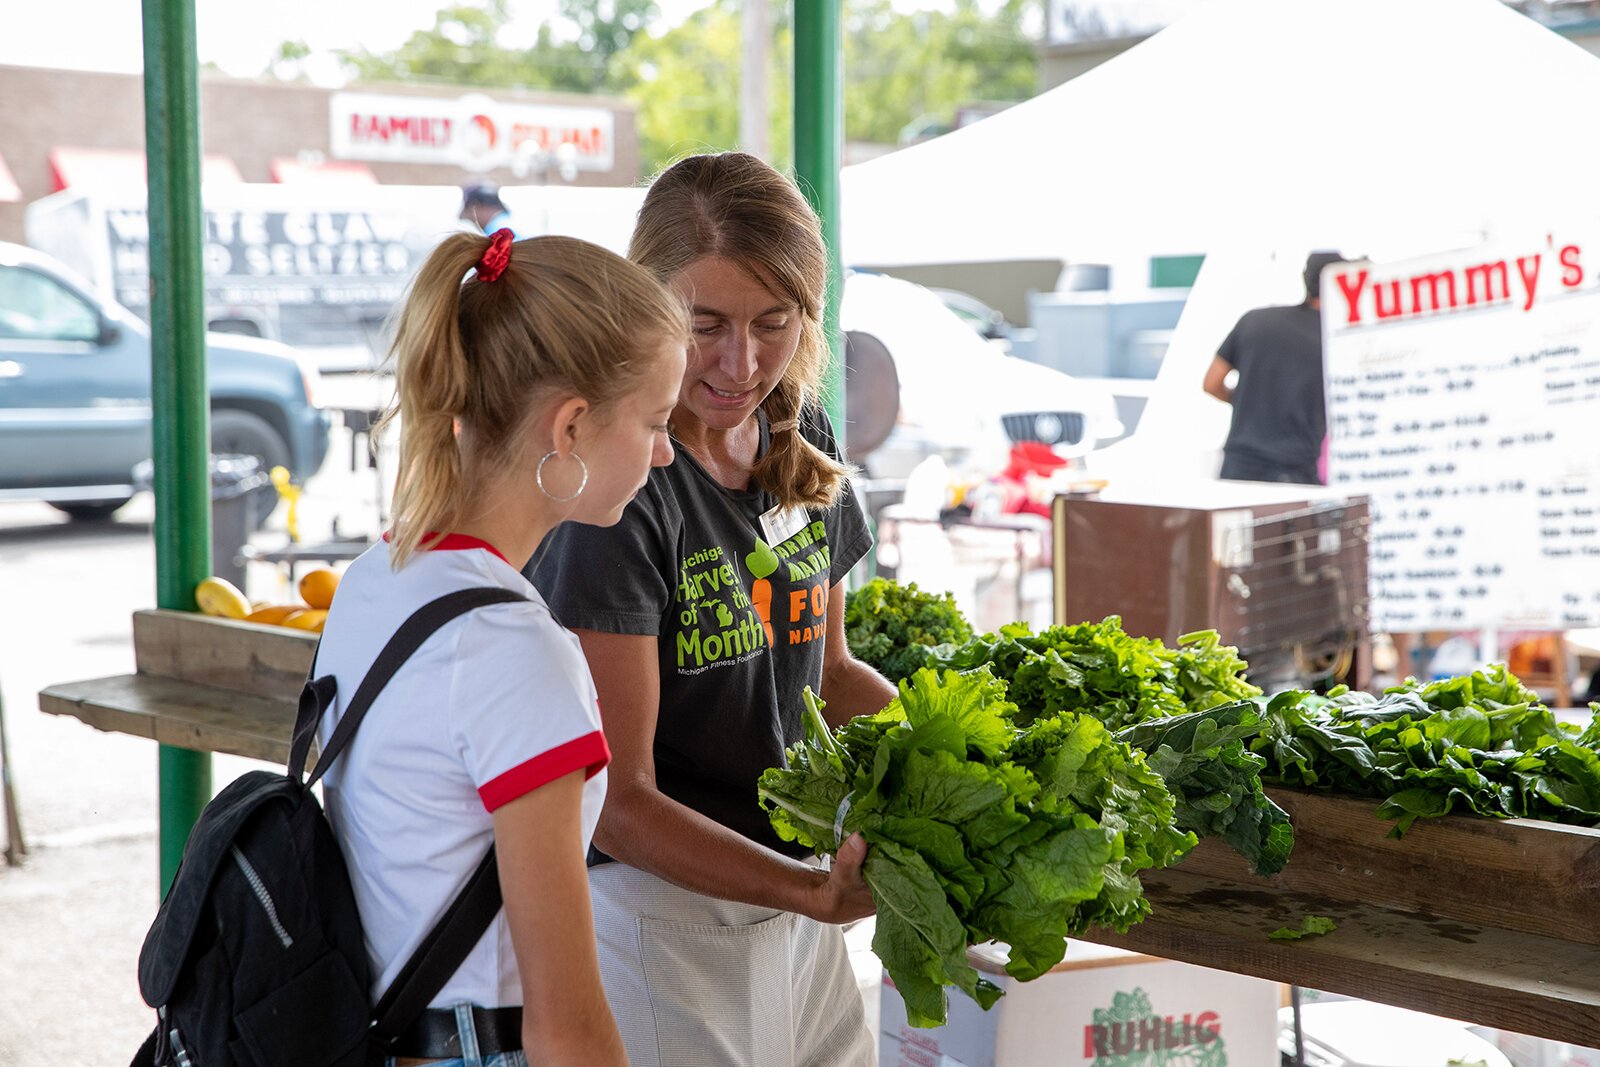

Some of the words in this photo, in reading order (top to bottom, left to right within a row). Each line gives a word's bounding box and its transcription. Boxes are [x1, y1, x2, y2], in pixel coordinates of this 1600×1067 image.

[1336, 233, 1584, 323] Yummy's
[676, 611, 764, 667] Month
[680, 602, 698, 626] of
[1083, 1010, 1222, 1058] RUHLIG
